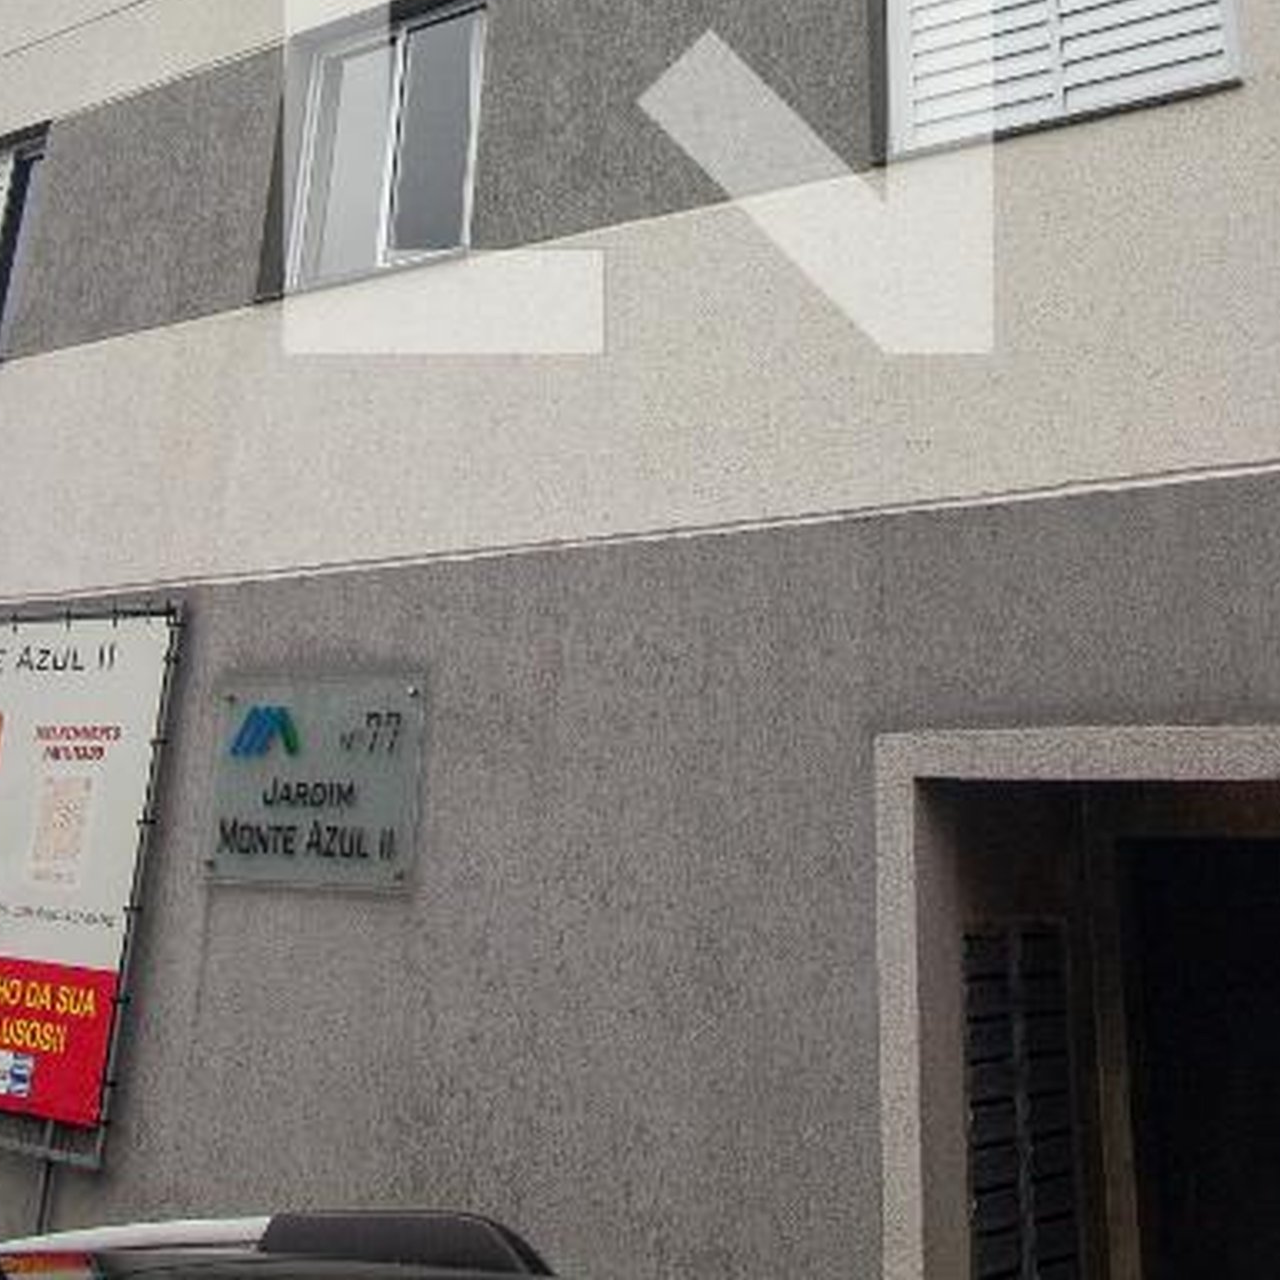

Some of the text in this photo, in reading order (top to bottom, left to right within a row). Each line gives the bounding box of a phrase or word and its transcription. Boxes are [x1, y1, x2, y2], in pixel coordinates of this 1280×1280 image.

[16, 643, 85, 671] AZUL
[262, 777, 356, 807] JARDIM
[217, 817, 297, 855] MONTE
[305, 819, 368, 859] AZUL
[25, 981, 52, 1012] DA
[56, 985, 96, 1018] SUA
